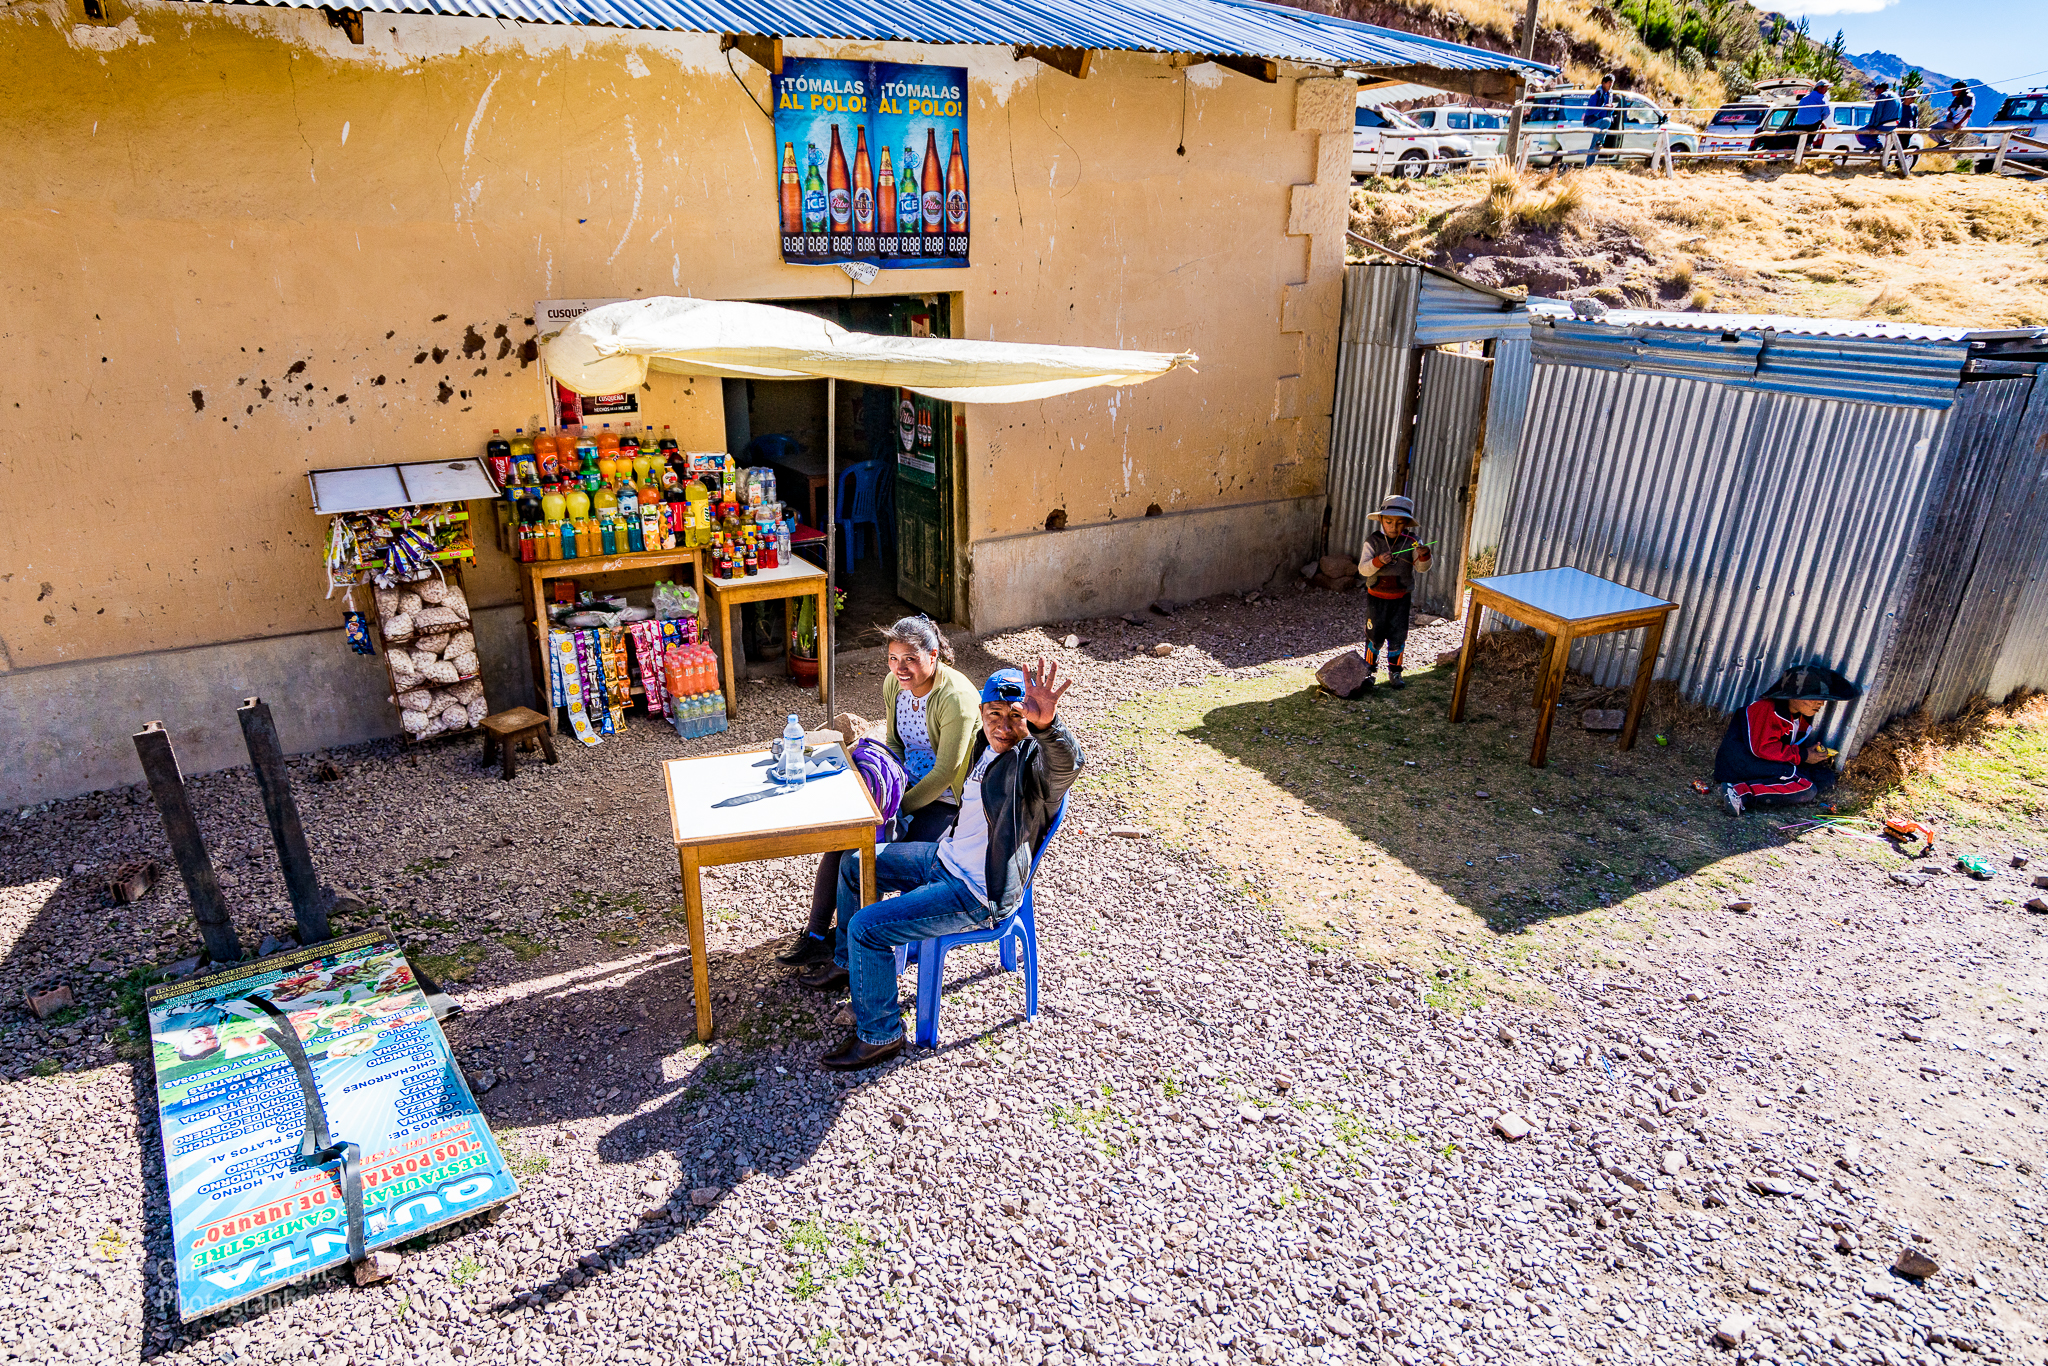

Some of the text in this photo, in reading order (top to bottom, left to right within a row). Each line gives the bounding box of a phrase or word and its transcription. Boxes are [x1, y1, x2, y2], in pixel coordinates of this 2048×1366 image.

[780, 75, 865, 95] ¡TÓMALAS
[880, 80, 961, 100] ¡TÓMALAS
[779, 93, 867, 113] AL POLO!
[878, 98, 962, 117] AL POLO!
[807, 198, 825, 210] ICE
[901, 200, 918, 211] ICE
[547, 306, 590, 318] CUSQUEÑ
[370, 1006, 421, 1026] BEBIDAS:
[312, 1022, 368, 1045] CERVEZA,
[376, 1021, 417, 1038] POLLO
[392, 1028, 420, 1041] CUY
[365, 1042, 427, 1068] CHANCHO
[371, 1035, 424, 1056] TRUCHA
[410, 1049, 434, 1062] DE:
[161, 1063, 229, 1090] GASEOSAS
[243, 1067, 261, 1079] DE
[261, 1065, 294, 1081] STEK
[341, 1058, 437, 1094] CHICHARRONES
[401, 1068, 439, 1086] MOTE
[186, 1072, 243, 1096] PATITAS
[225, 1082, 265, 1101] FRITO
[227, 1080, 246, 1092] LO
[398, 1076, 443, 1096] PANZA
[180, 1086, 226, 1106] POBRE
[218, 1089, 303, 1123] RUCHA FRITA
[237, 1094, 258, 1107] DE
[393, 1084, 447, 1108] PATITAS
[397, 1092, 450, 1116] CABEZA
[172, 1097, 306, 1147] ECHÓN DE CORDERO
[178, 1100, 236, 1126] TRUCHA
[396, 1101, 454, 1127] GALLINA
[242, 1120, 264, 1134] DE
[387, 1108, 463, 1141] CALDOS DE:
[429, 1119, 472, 1141] PASE
[171, 1127, 243, 1158] CHANCHO
[207, 1135, 281, 1165] PLATOS AL
[278, 1143, 299, 1157] AL
[224, 1150, 278, 1176] HORNO
[252, 1162, 274, 1177] AL
[196, 1169, 251, 1196] HORNO
[210, 1169, 284, 1202] AL HORNO
[298, 1188, 327, 1211] DE
[192, 1203, 337, 1270] CAMPESTRE
